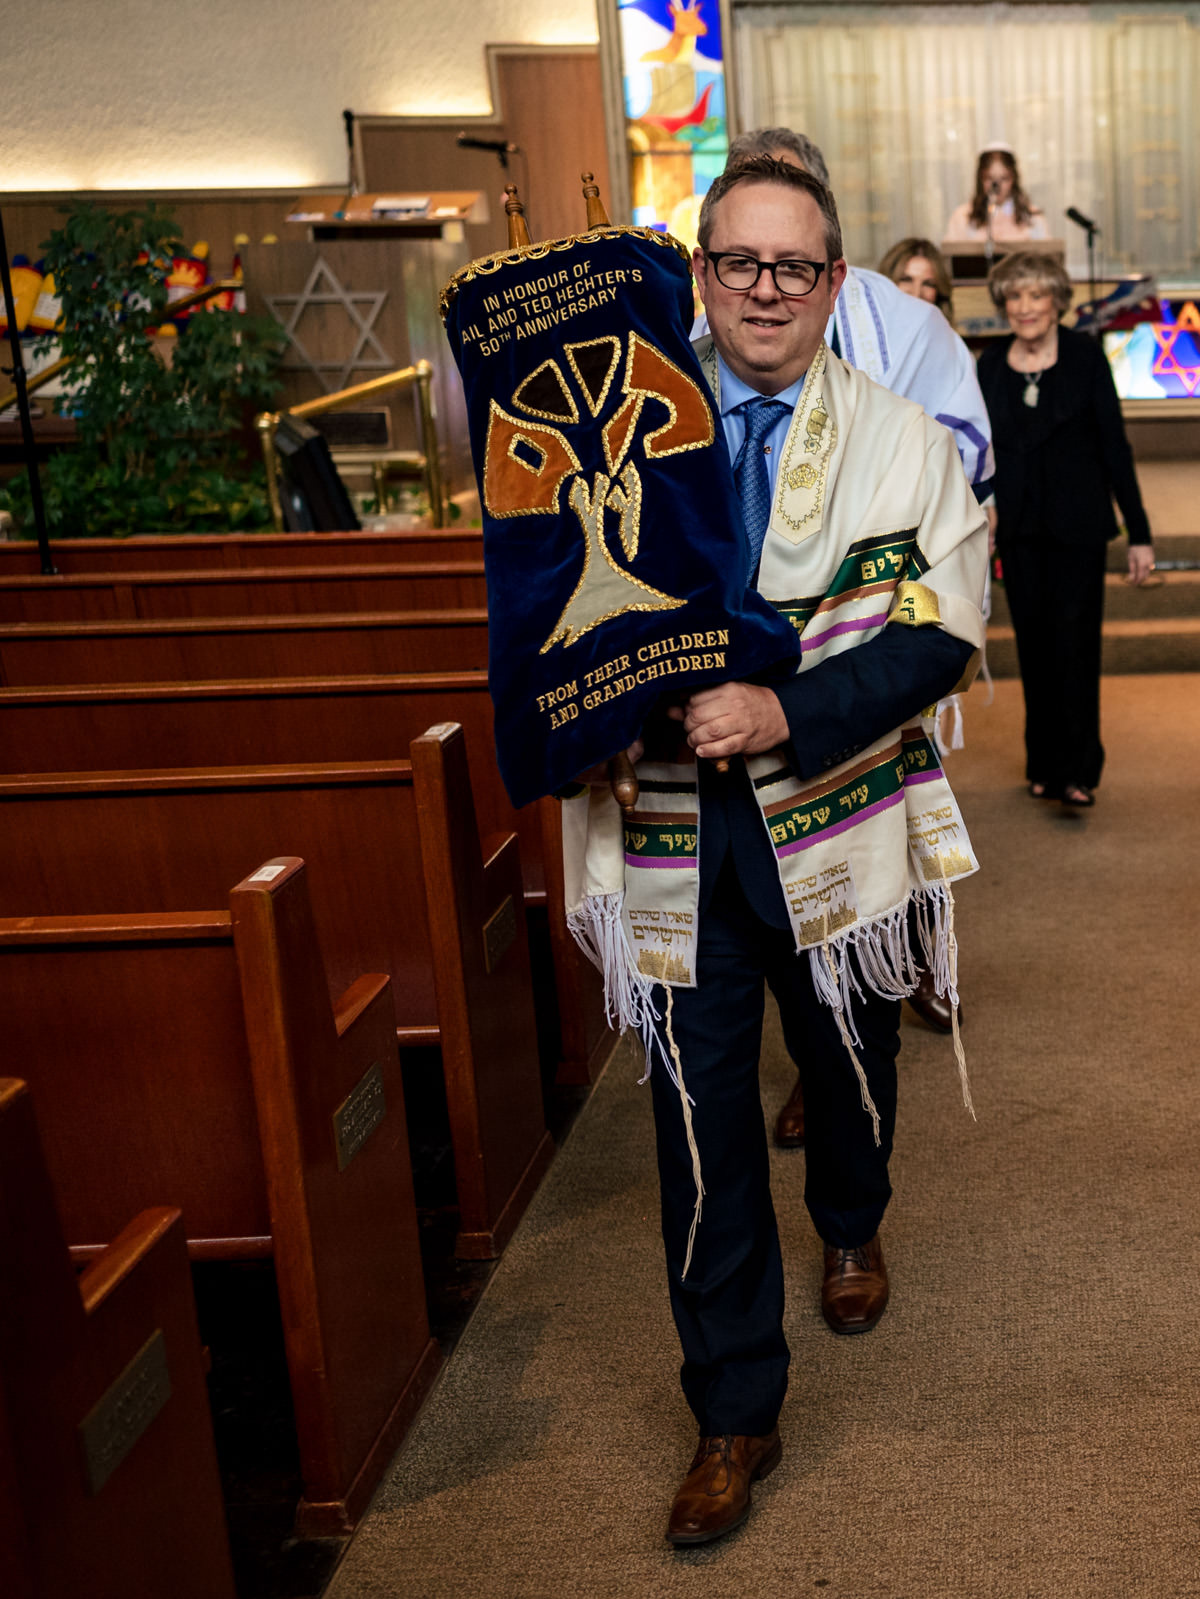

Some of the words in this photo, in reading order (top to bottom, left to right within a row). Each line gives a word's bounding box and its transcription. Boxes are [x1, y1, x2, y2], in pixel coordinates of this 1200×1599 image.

[461, 323, 485, 344] AIL
[488, 308, 518, 333] AND
[520, 295, 552, 316] TED
[556, 269, 643, 304] HECHTER'S
[483, 294, 500, 313] IN
[503, 270, 569, 305] HONOUR
[572, 260, 592, 278] OF
[516, 287, 617, 340] ANNIVERSARY
[536, 680, 578, 712] FROM
[583, 655, 631, 688] THEIR
[637, 629, 730, 663] CHILDREN
[550, 703, 579, 730] AND
[582, 652, 726, 710] GRANDCHILDREN
[839, 784, 869, 811] עיר
[659, 833, 697, 851] עיר
[770, 806, 831, 844] שלום
